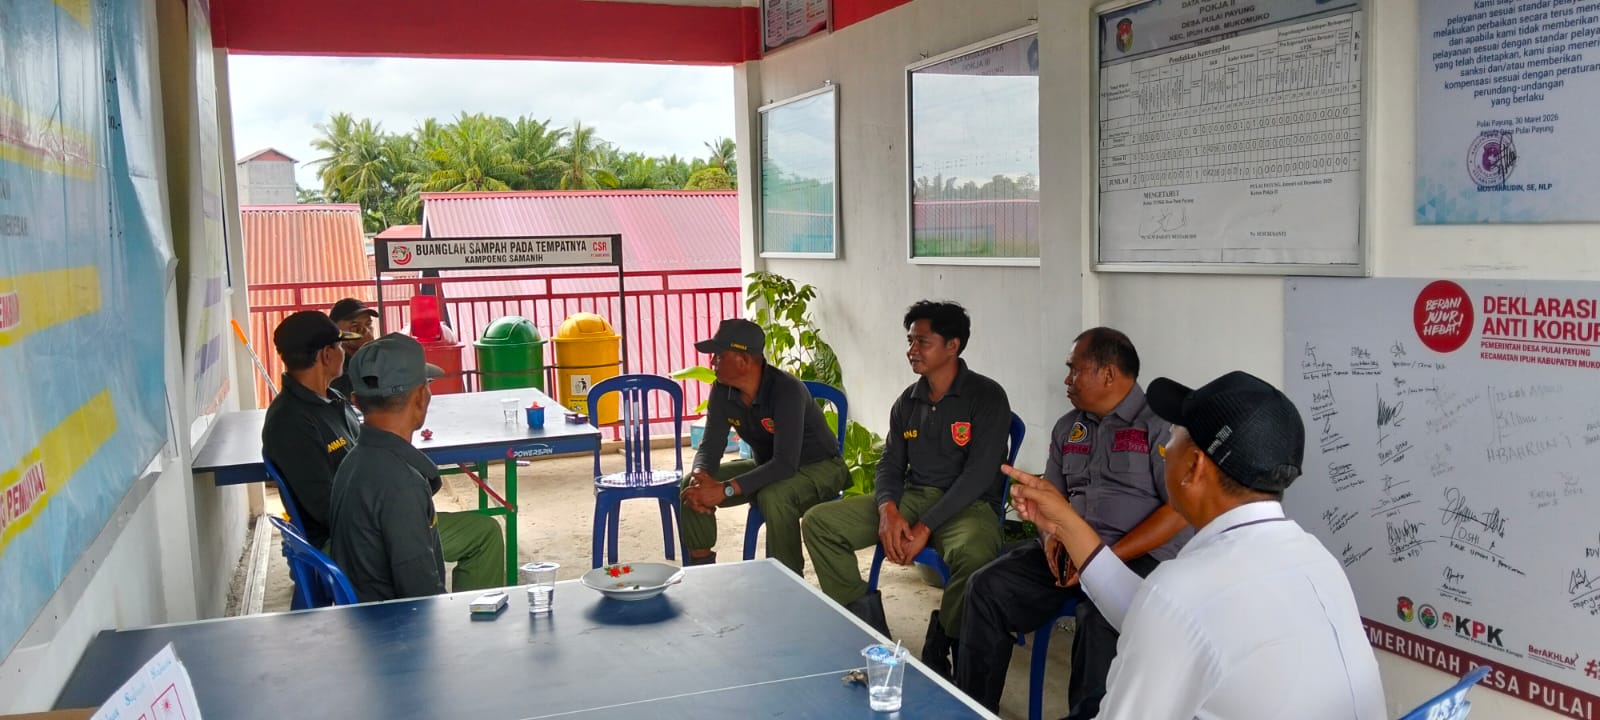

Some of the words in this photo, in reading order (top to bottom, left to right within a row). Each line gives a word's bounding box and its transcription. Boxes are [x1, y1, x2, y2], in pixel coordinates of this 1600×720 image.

[1199, 1, 1228, 14] POKJA
[1447, 12, 1487, 26] pelayanan
[1489, 6, 1516, 18] sesuai
[1518, 0, 1550, 12] standar
[1474, 0, 1495, 9] Kami
[1169, 33, 1186, 41] KEC.
[1186, 29, 1203, 38] IPUH
[1204, 24, 1222, 32] KAB.
[1223, 12, 1270, 28] MUKOMUKO
[1181, 20, 1200, 29] DESA
[1202, 14, 1223, 24] PULAI
[1224, 5, 1256, 18] PAYUNG
[1433, 25, 1475, 38] melakukan
[1477, 17, 1517, 32] perbaikan
[1520, 12, 1548, 24] secara
[1550, 8, 1574, 18] terus
[1448, 38, 1464, 46] dan
[1465, 31, 1494, 44] apabila
[1496, 28, 1516, 39] kami
[1518, 24, 1540, 35] tidak
[1542, 16, 1599, 31] memberikan
[1432, 47, 1472, 60] pelayanan
[1473, 42, 1500, 54] sesuai
[1502, 38, 1532, 49] dengan
[1534, 32, 1568, 44] standar
[1434, 60, 1454, 72] yang
[1455, 56, 1474, 67] telah
[1476, 52, 1522, 66] ditetapkan,
[1524, 45, 1544, 58] kami
[1546, 44, 1566, 54] siap
[1460, 67, 1486, 77] sanksi
[1488, 62, 1524, 74] dan/atau
[1527, 54, 1582, 69] memberikan
[1444, 77, 1491, 90] kompensasi
[1493, 73, 1520, 84] sesuai
[1522, 68, 1554, 80] dengan
[1556, 63, 1600, 78] peraturan
[1474, 79, 1564, 98] perundang-undangan
[1490, 95, 1511, 108] yang
[1512, 92, 1544, 104] berlaku
[1492, 118, 1513, 128] Payung,
[1532, 125, 1554, 134] Payung
[416, 243, 466, 256] BUANGLAH
[469, 242, 507, 254] SAMPAH
[510, 241, 534, 253] PADA
[536, 240, 586, 252] TEMPATNYA
[592, 241, 607, 251] CSR
[465, 255, 507, 264] KAMPOENG
[509, 254, 544, 262] SAMANIH
[1426, 297, 1462, 312] BERANI
[1483, 296, 1597, 319] DEKLARASI
[1424, 310, 1459, 326] JUJUR
[1424, 314, 1464, 336] HEBAT!
[1482, 317, 1527, 338] ANTI
[1480, 352, 1518, 362] KECAMATAN
[1520, 356, 1536, 364] IPUH
[1537, 357, 1577, 367] KABUPATEN
[1481, 341, 1521, 351] PEMERINTAH
[1523, 344, 1539, 352] DESA
[1541, 346, 1561, 354] PULAI
[1563, 347, 1590, 356] PAYUNG
[1455, 616, 1504, 647] KPK
[1528, 644, 1578, 666] BerAKHLAK
[1363, 625, 1460, 674] MERINTAH
[1528, 681, 1593, 720] PULAI
